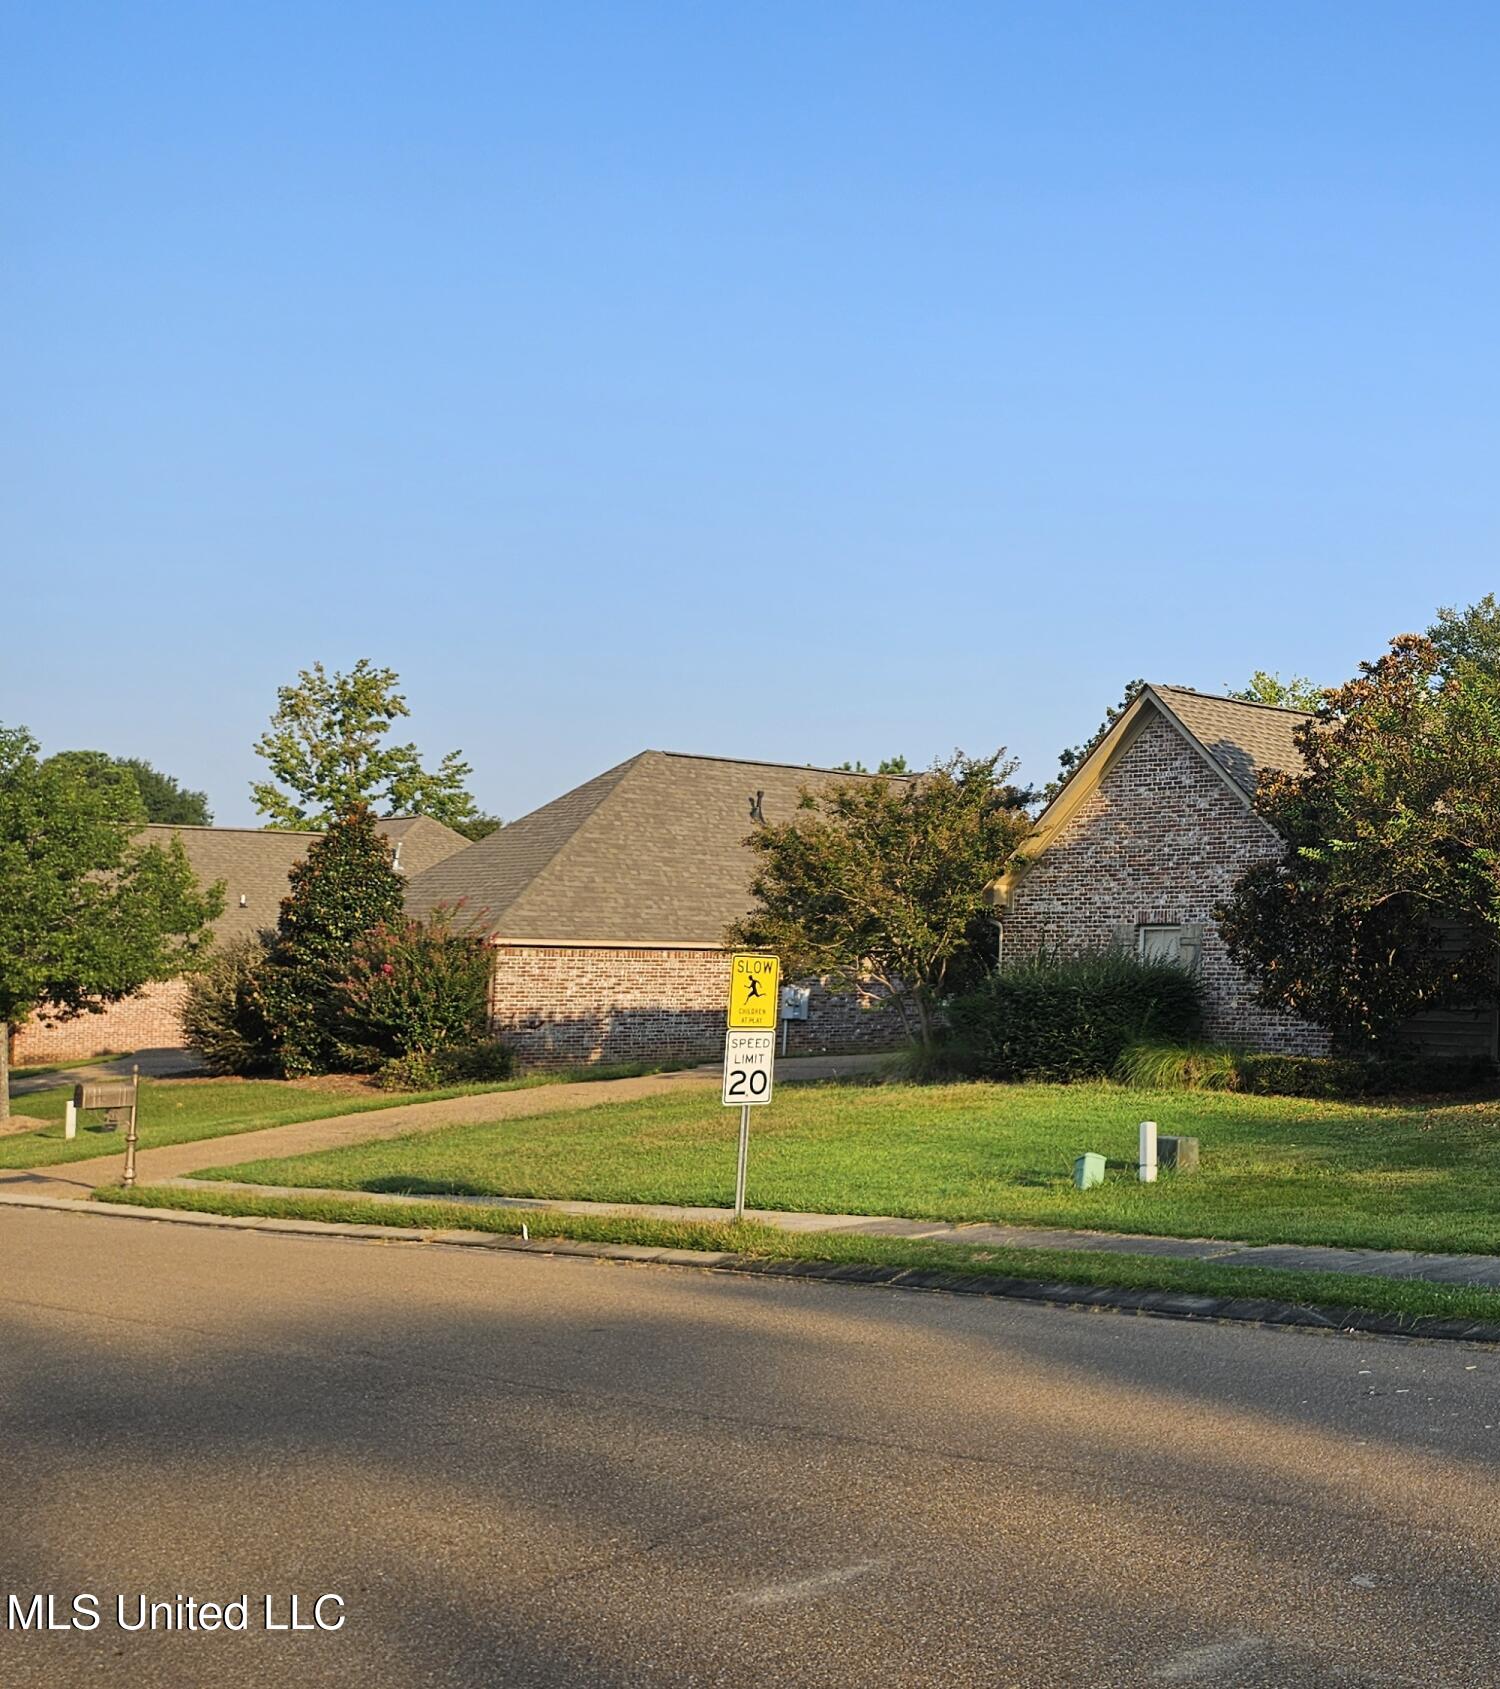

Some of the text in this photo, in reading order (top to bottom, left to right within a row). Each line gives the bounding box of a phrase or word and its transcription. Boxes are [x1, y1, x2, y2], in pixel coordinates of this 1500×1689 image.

[737, 960, 773, 974] SLOW
[731, 1038, 770, 1048] SPEED
[734, 1054, 764, 1064] LIMIT
[729, 1070, 767, 1095] 20
